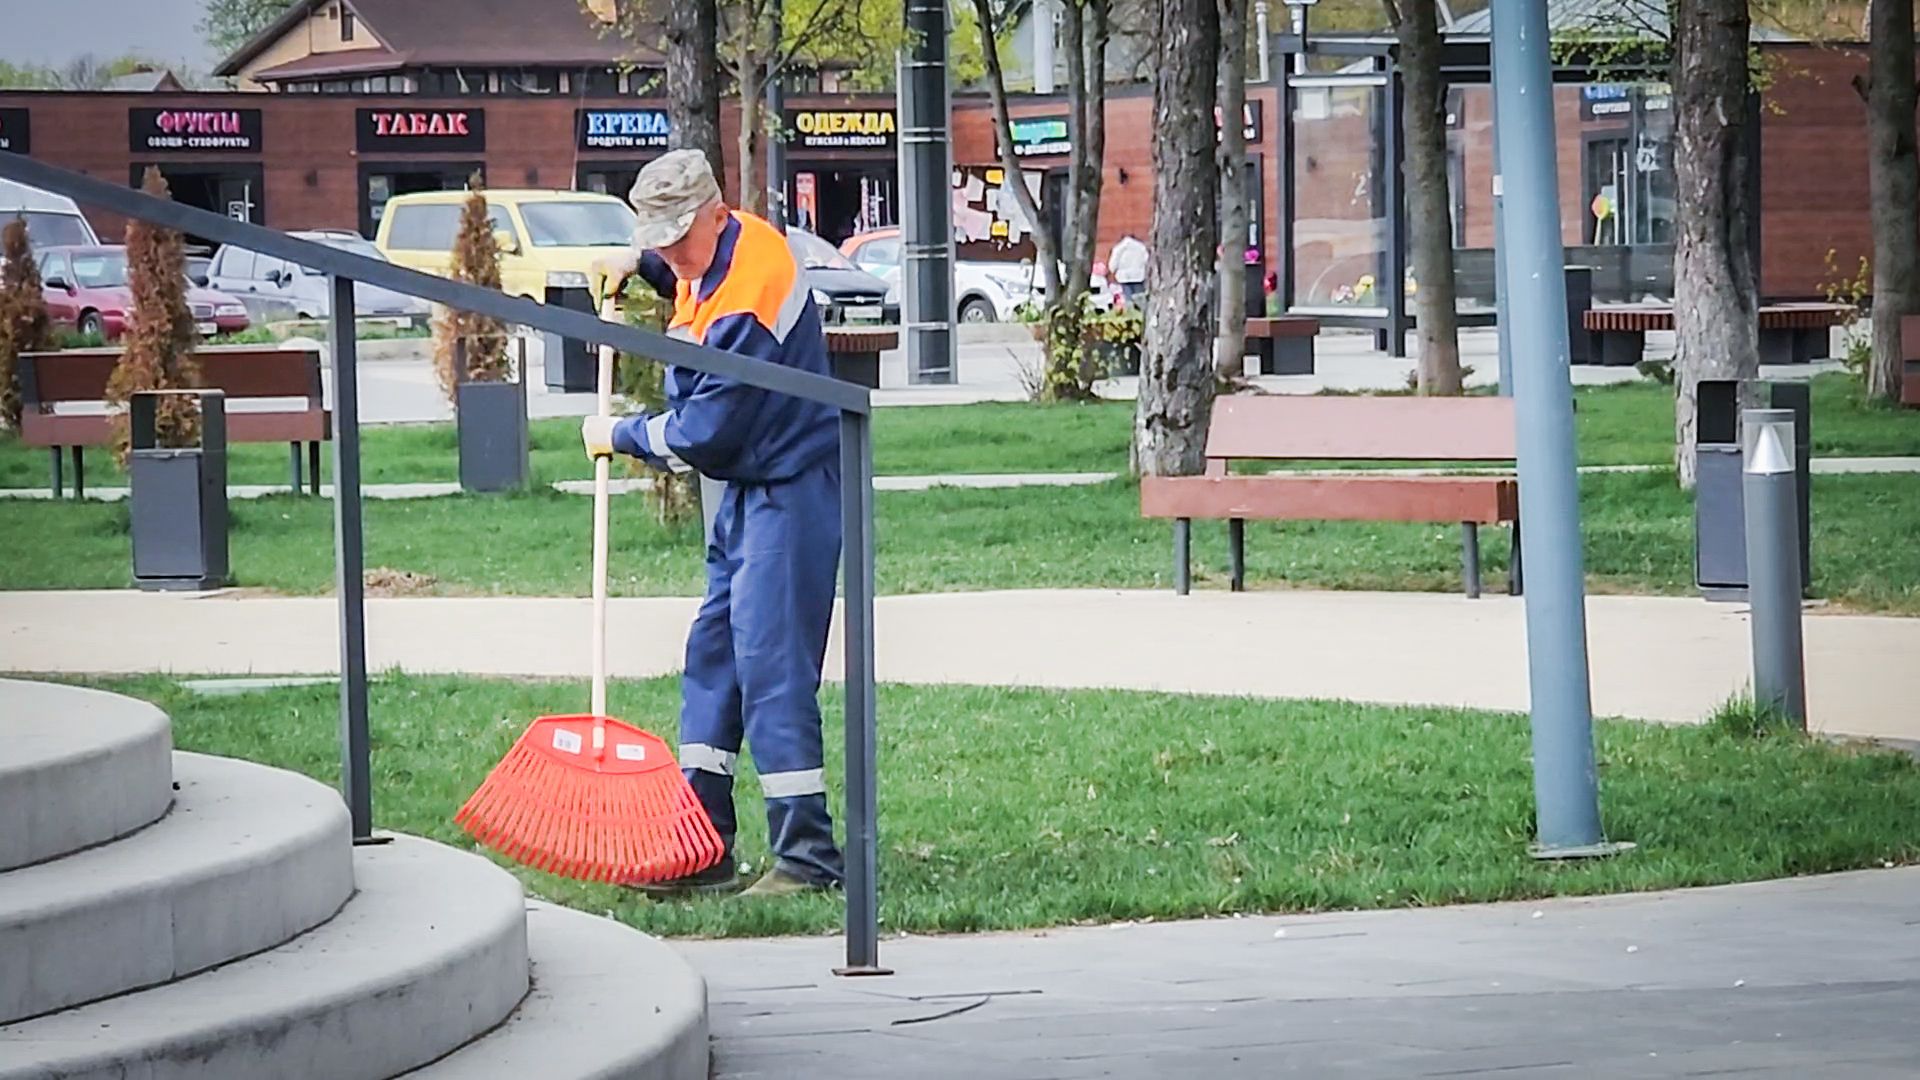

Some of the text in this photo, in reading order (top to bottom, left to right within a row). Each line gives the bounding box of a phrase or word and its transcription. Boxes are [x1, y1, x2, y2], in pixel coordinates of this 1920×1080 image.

[156, 111, 241, 133] ФРУКТЫ
[372, 113, 469, 135] ТАБАК
[796, 112, 895, 135] ОДЕЖДА
[147, 136, 250, 147] ОВОЩИ СУХОФРУКТЫ
[587, 136, 634, 147] ПРОДУКТЫ
[804, 136, 843, 146] МУЖСКАЯ
[850, 136, 887, 146] ЖЕНСКАЯ
